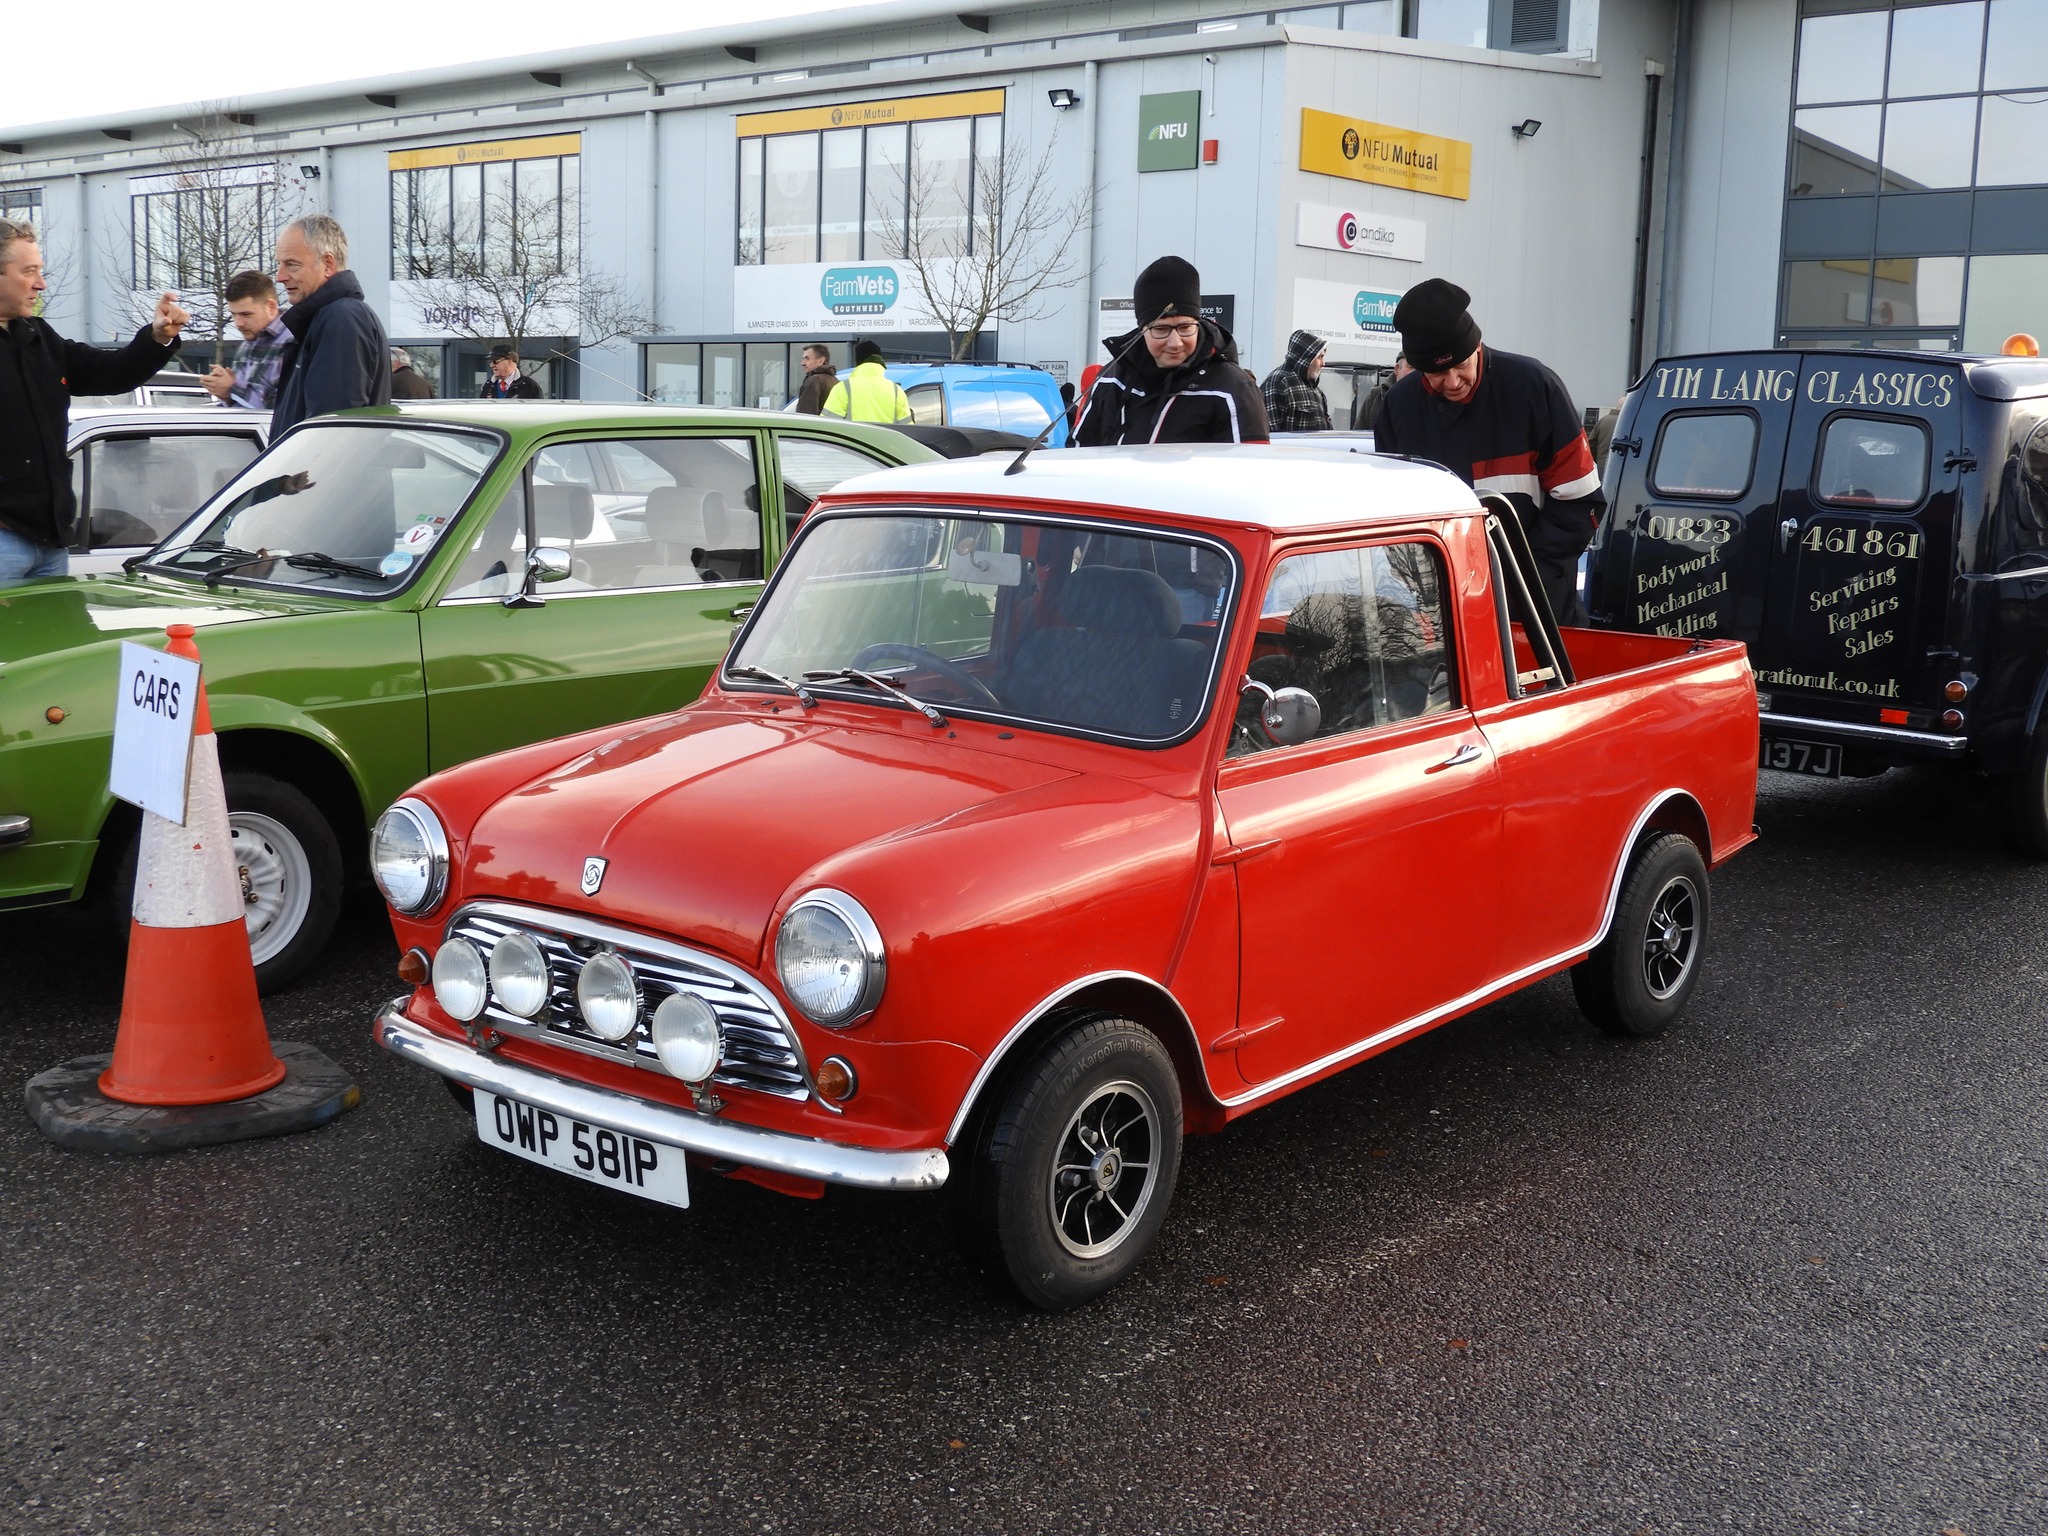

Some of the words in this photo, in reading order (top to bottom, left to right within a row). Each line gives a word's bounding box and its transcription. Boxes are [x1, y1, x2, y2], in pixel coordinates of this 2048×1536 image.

[844, 109, 862, 122] NFU
[863, 106, 895, 120] Mutual
[1159, 123, 1188, 140] NFU
[480, 146, 504, 157] Mutual
[1363, 138, 1389, 161] NFU
[1392, 145, 1438, 171] Mutual
[1363, 163, 1385, 173] INSURANCE
[1388, 167, 1408, 177] PENSIONS
[1411, 172, 1437, 183] INVESTMENTS
[1361, 227, 1395, 243] andika
[825, 275, 895, 297] FarmVets
[423, 305, 481, 330] voyage
[834, 304, 884, 313] SOUTHWEST
[1215, 306, 1223, 314] to
[748, 320, 775, 329] ILMINSTER
[776, 320, 791, 328] 01460
[792, 320, 808, 328] 55004
[820, 319, 856, 327] BRIDGWATER
[857, 319, 872, 327] 01278
[873, 318, 895, 327] 663399
[908, 318, 941, 326] YARCOMBE
[1656, 367, 1704, 399] TIM
[1711, 368, 1795, 402] LANG
[1807, 371, 1954, 407] CLASSICS
[410, 530, 427, 543] V
[1648, 515, 1731, 544] 01823
[1637, 546, 1720, 594] Bodywork
[1637, 572, 1728, 625] Mechanical
[1810, 566, 1897, 612] Servicing
[1655, 611, 1718, 638] Welding
[1828, 596, 1899, 635] Repairs
[1845, 628, 1894, 659] Sales
[133, 669, 181, 720] CARS
[1078, 1039, 1129, 1073] KargoTrail
[1130, 1039, 1142, 1052] 3G
[493, 1096, 559, 1157] OWP
[571, 1123, 658, 1187] 581P
